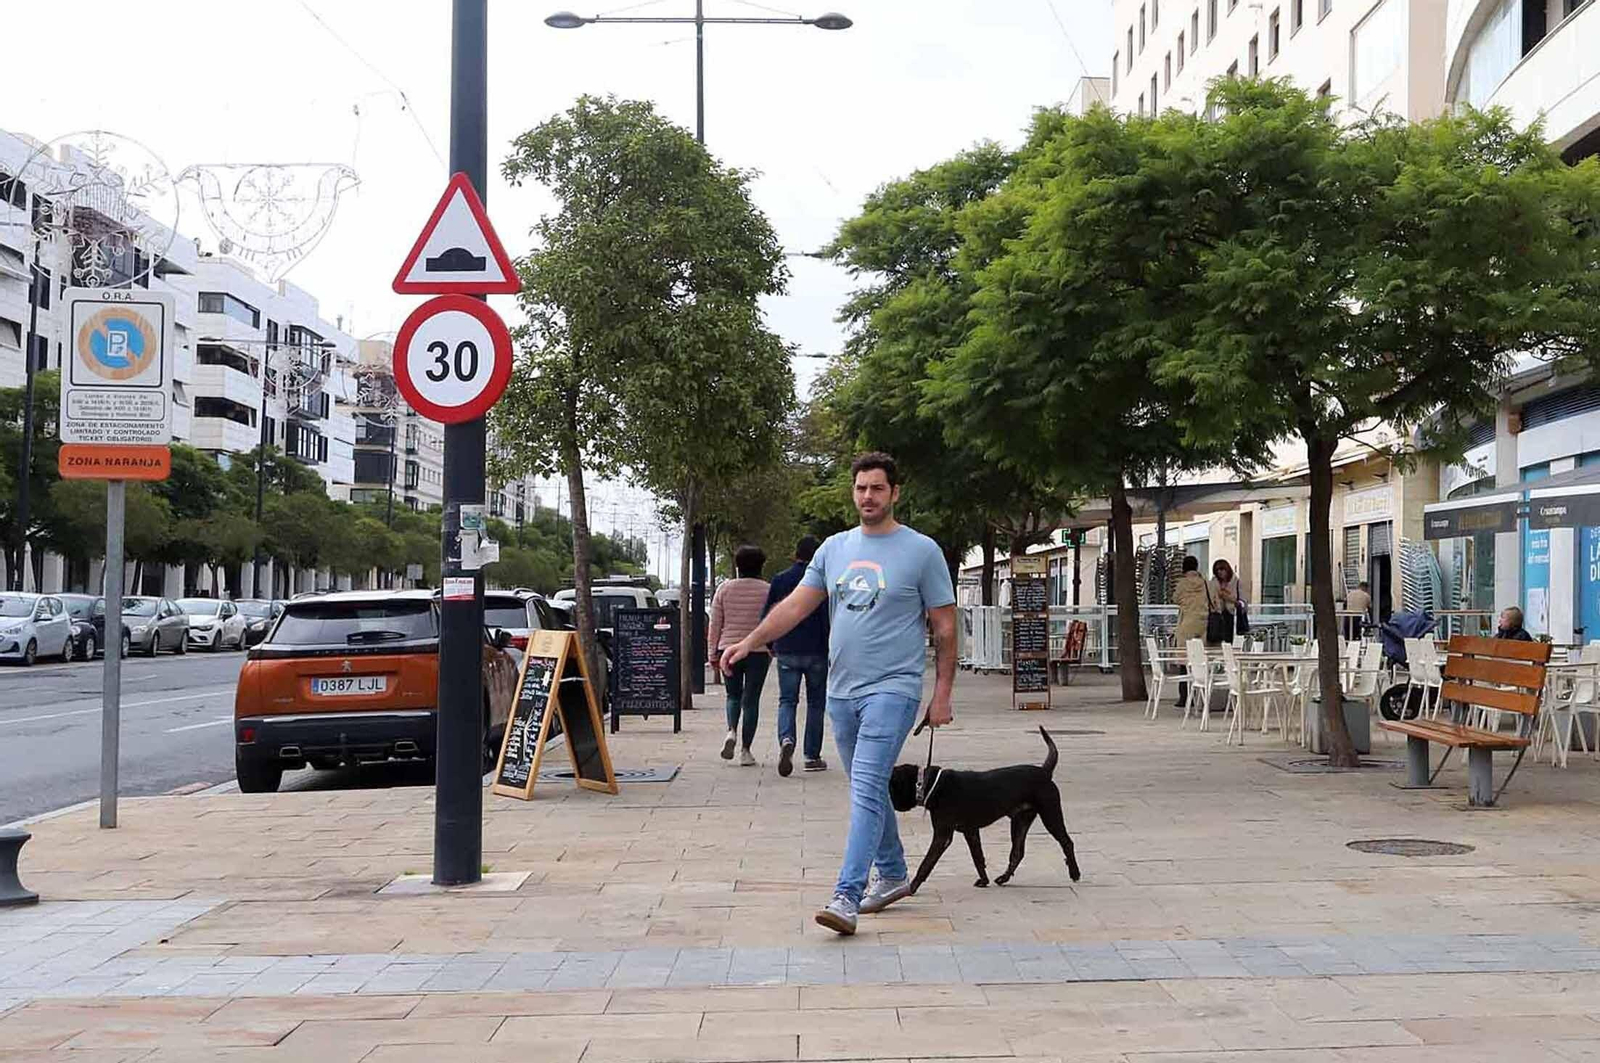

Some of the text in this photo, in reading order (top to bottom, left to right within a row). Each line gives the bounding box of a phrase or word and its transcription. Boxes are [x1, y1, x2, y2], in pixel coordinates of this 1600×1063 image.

[102, 291, 134, 301] O.R.A.
[109, 332, 126, 354] P
[425, 340, 479, 382] 30
[106, 435, 153, 443] OBLIGATORIO
[68, 456, 162, 467] ZONA NARANJA
[320, 678, 383, 692] 0387 LJL
